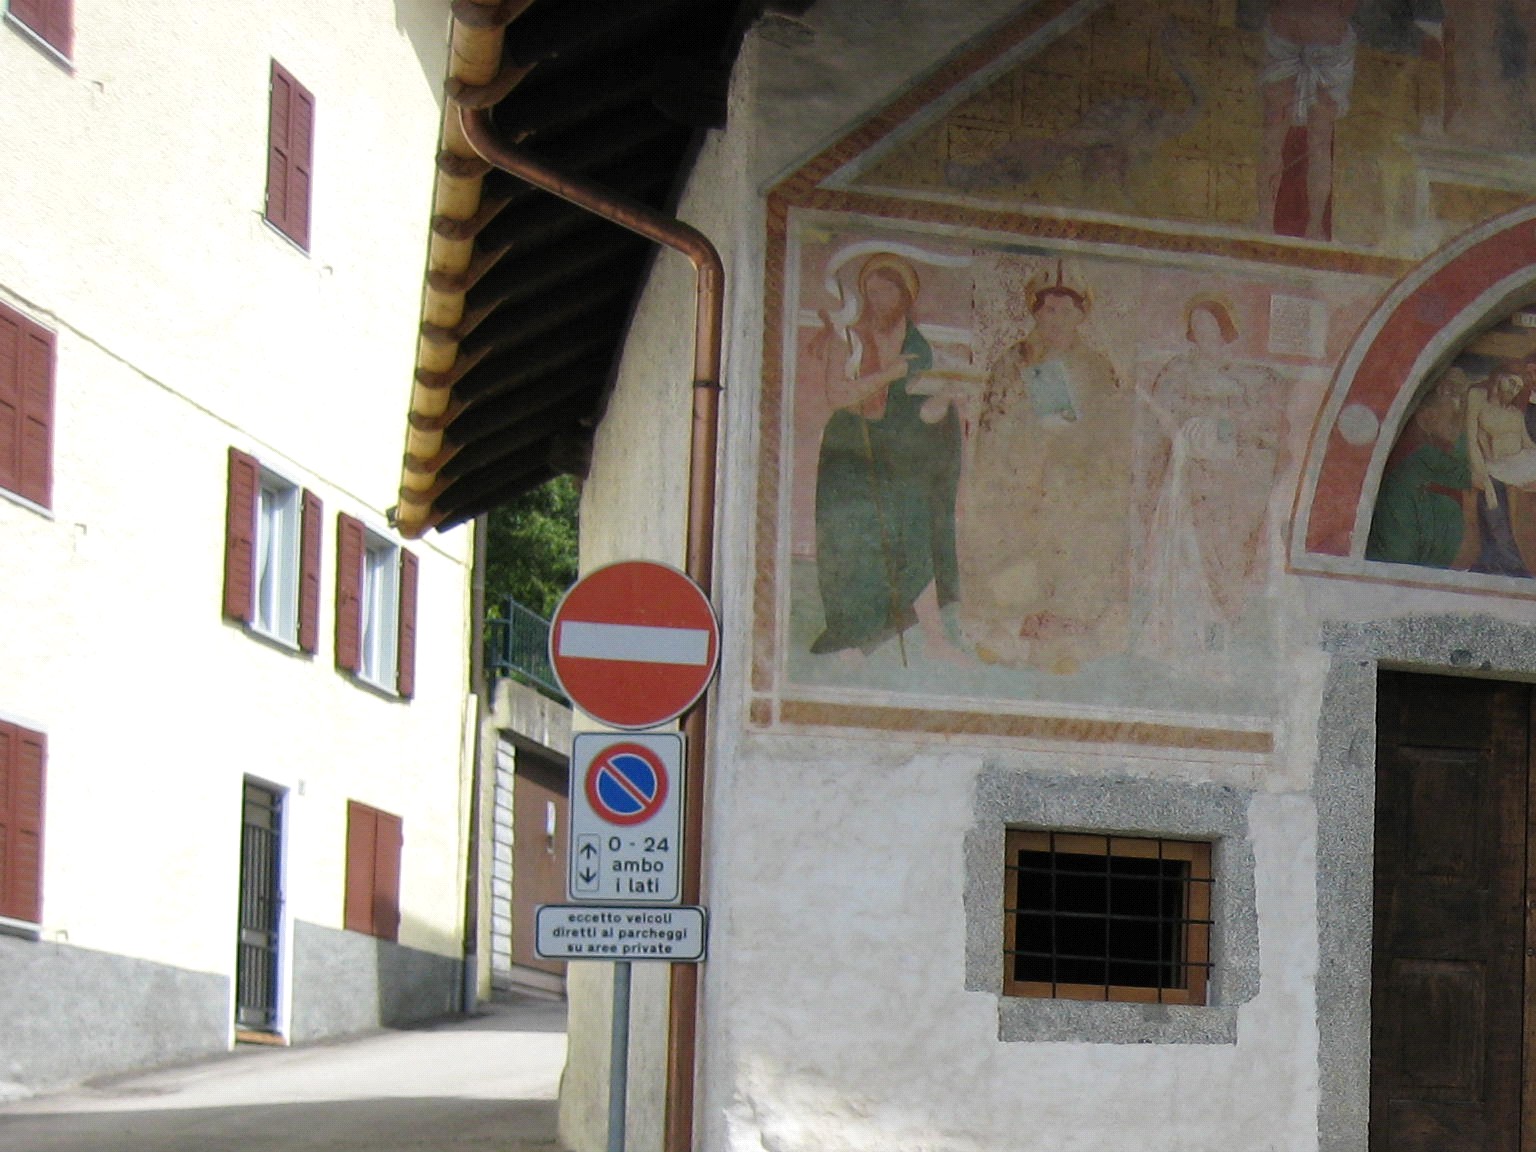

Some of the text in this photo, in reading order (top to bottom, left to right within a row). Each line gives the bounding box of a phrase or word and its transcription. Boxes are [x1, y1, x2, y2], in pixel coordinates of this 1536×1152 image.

[608, 836, 621, 852] 0
[644, 836, 670, 852] 24
[612, 857, 664, 873] ambo
[616, 877, 659, 893] i lati
[568, 913, 672, 924] eccetto veicoli
[553, 927, 687, 941] diretti ai parcheggi
[567, 943, 673, 955] su aree private
